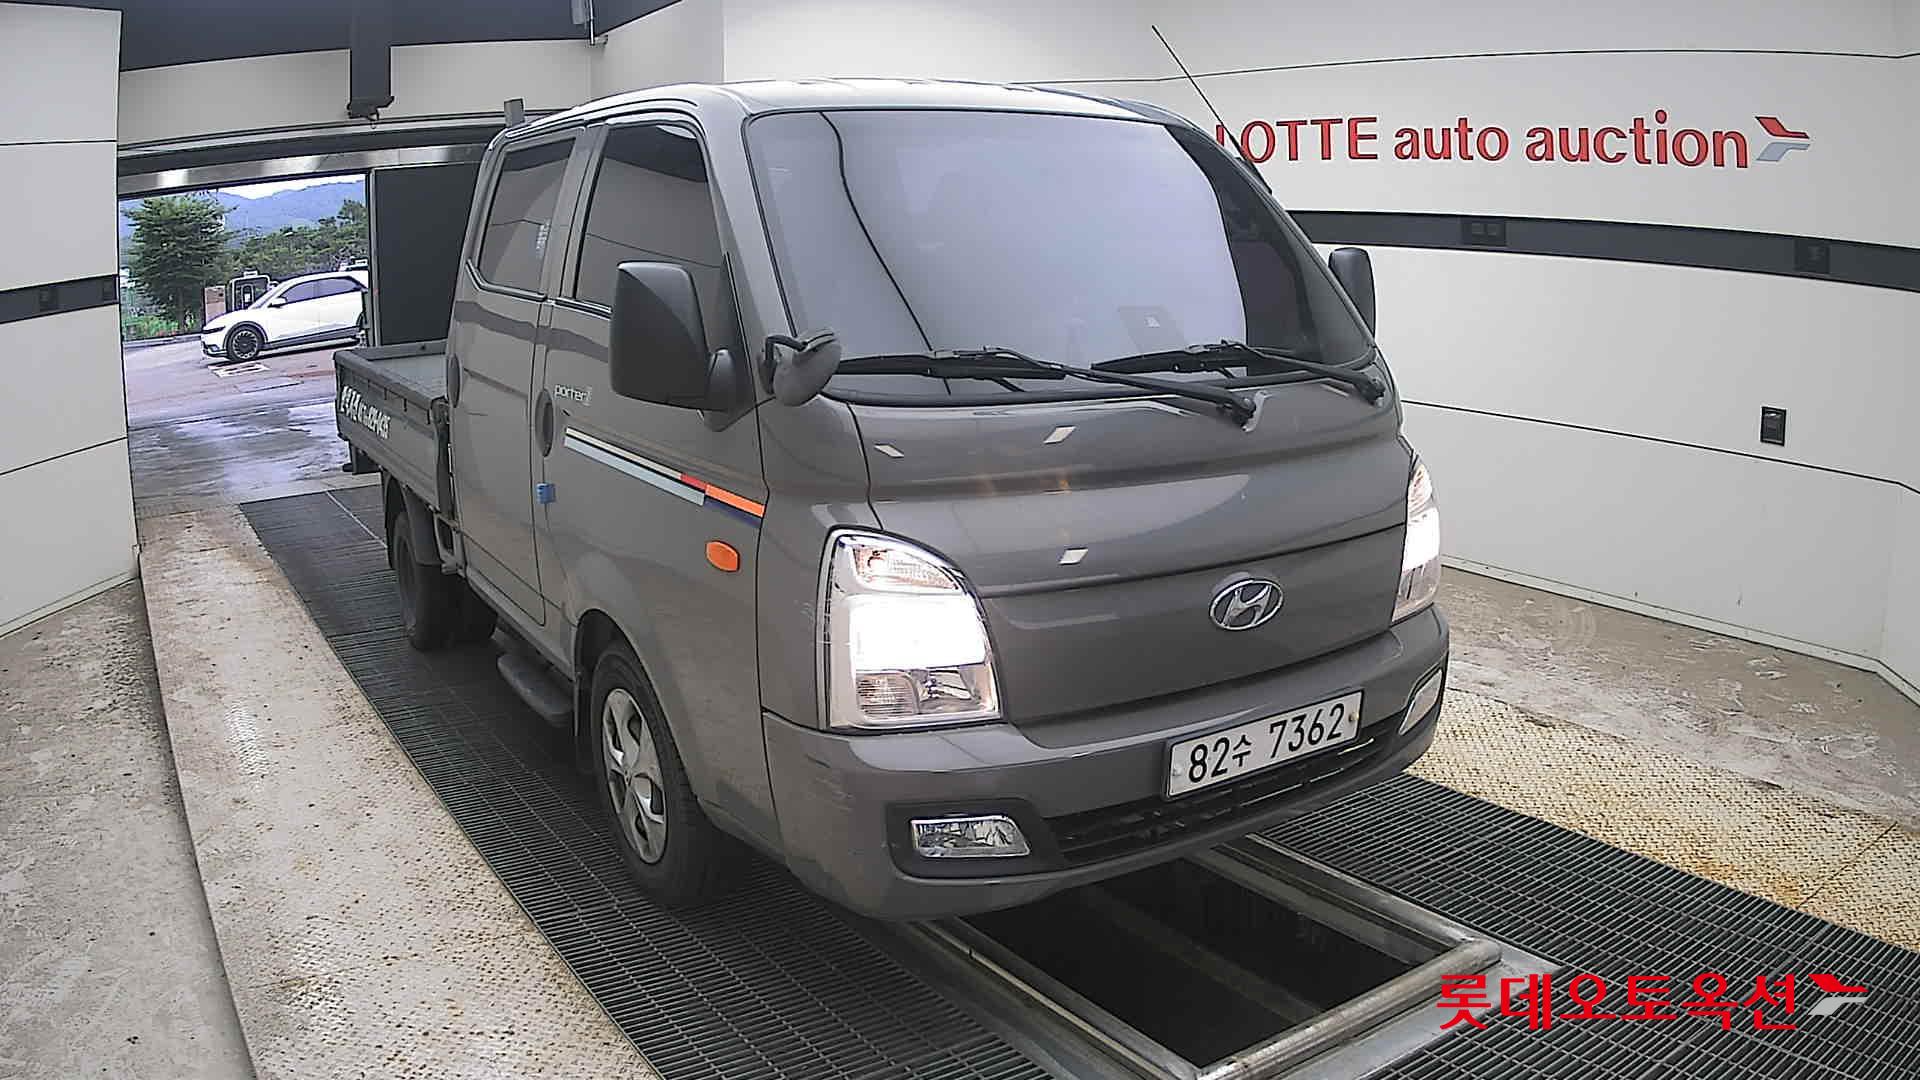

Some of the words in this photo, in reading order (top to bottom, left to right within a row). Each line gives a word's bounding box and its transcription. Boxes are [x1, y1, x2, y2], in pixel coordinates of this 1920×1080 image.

[1394, 117, 1509, 161] auto
[1525, 110, 1749, 168] auction
[1188, 734, 1252, 783] 82수
[1269, 703, 1345, 759] 7362
